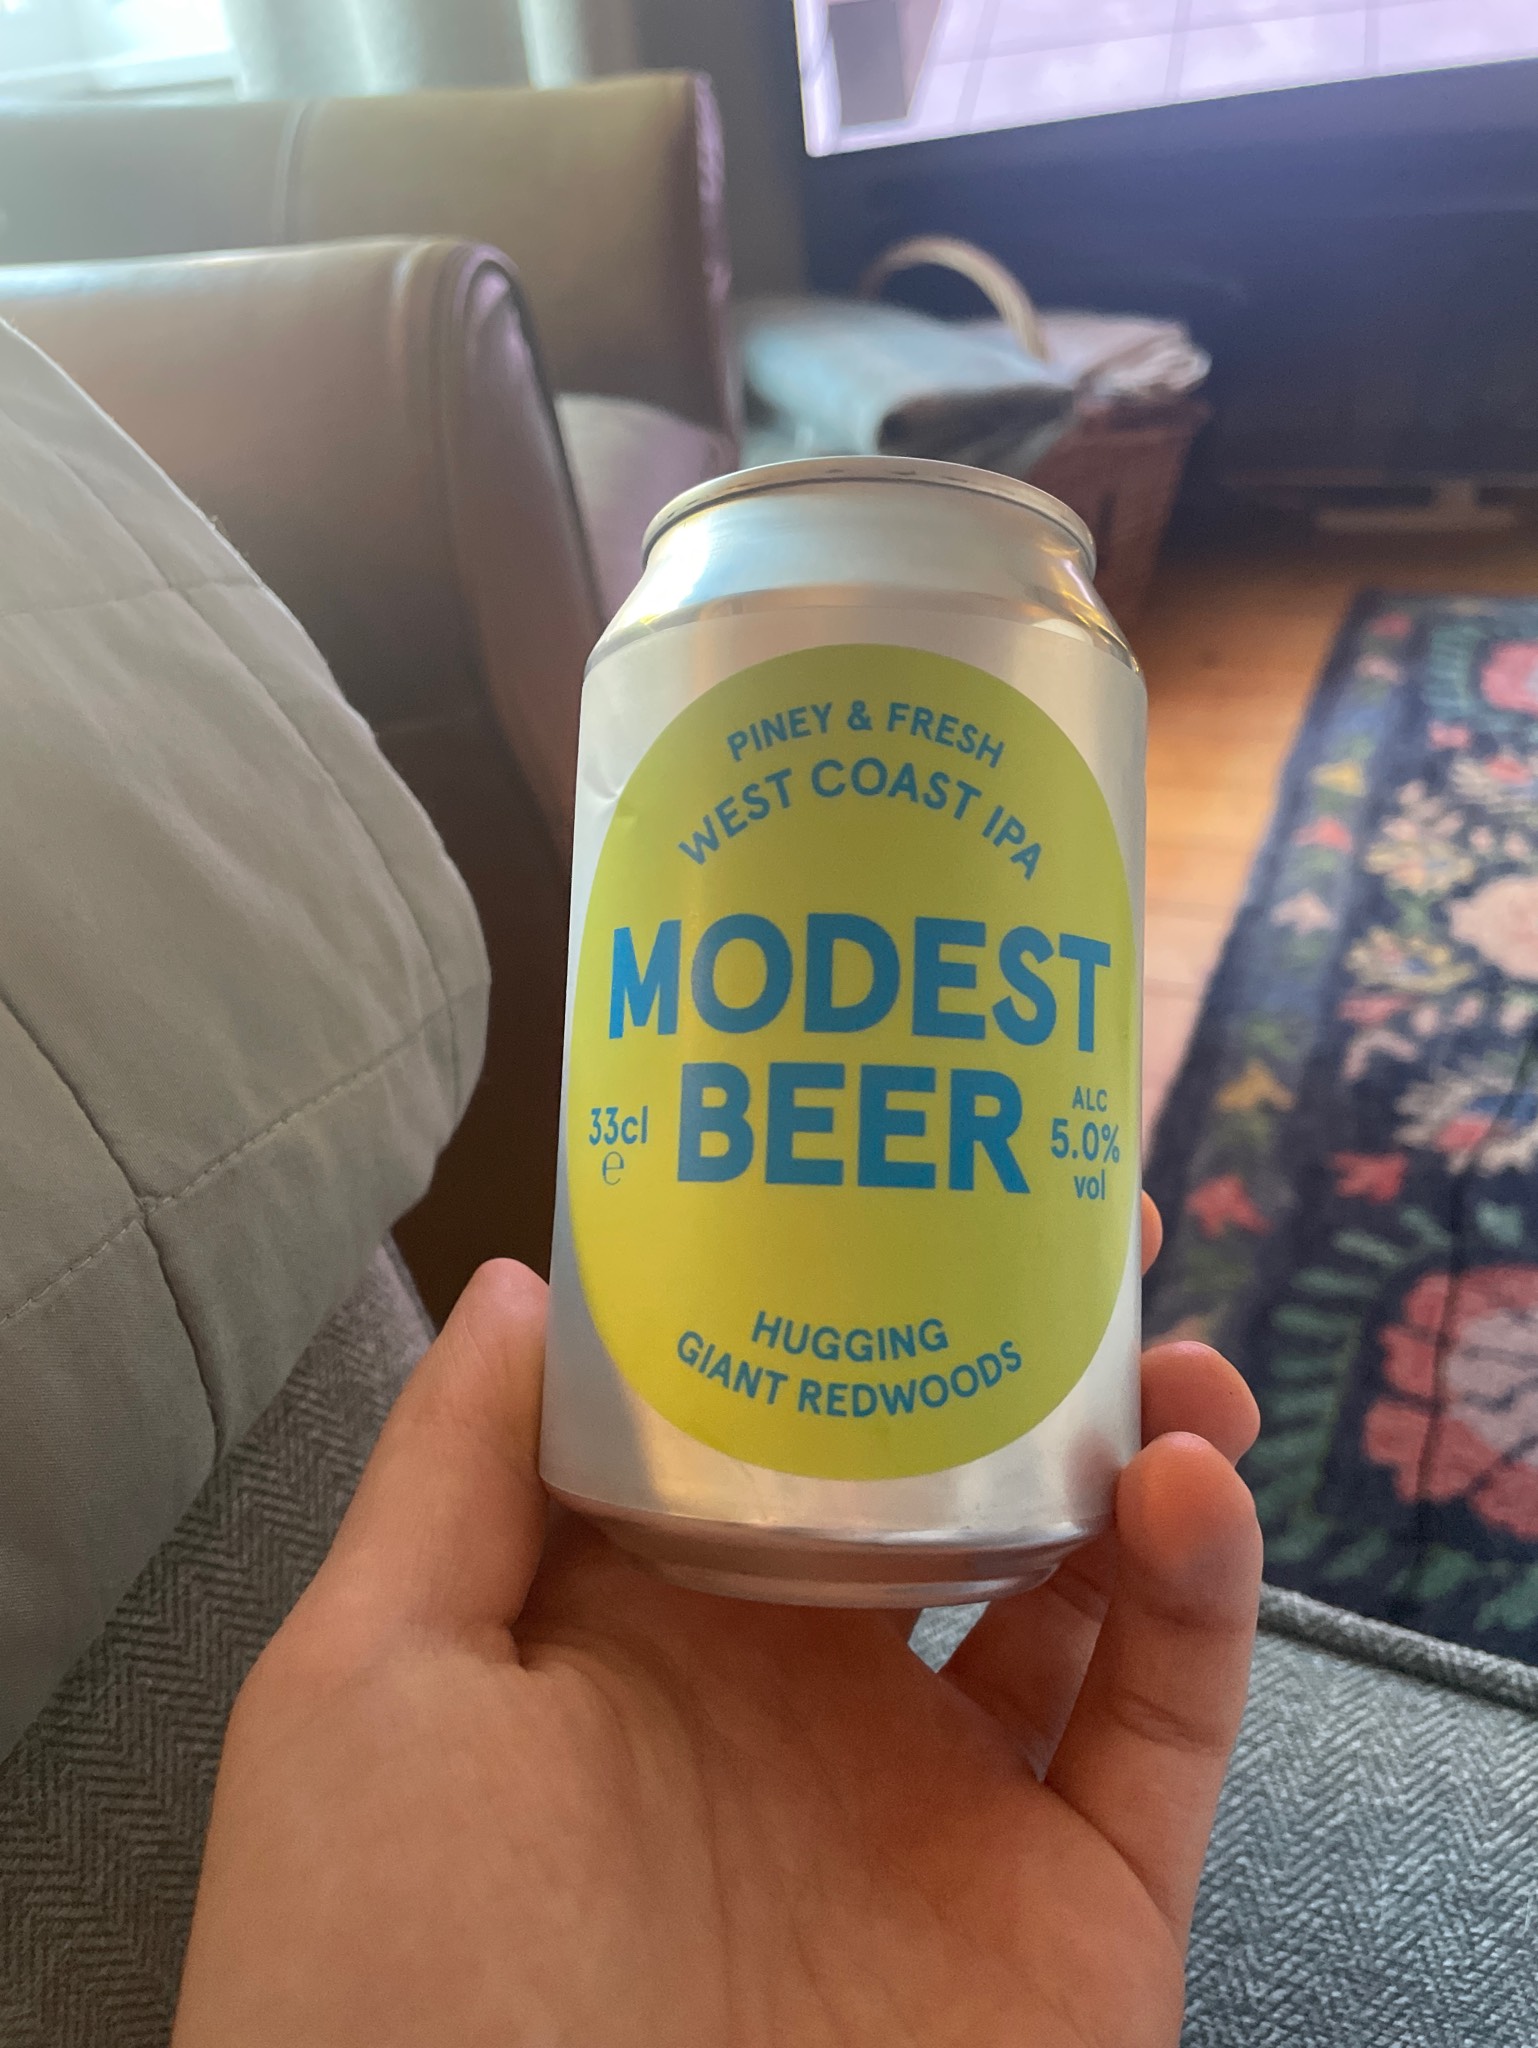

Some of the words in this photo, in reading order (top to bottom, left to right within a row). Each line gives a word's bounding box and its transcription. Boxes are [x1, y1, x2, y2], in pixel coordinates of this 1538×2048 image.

[727, 701, 833, 762] PINEY
[847, 700, 872, 730] &
[887, 702, 1005, 768] FRESH
[678, 768, 793, 865] WEST
[810, 757, 982, 820] COAST
[982, 806, 1042, 880] IPA
[609, 913, 1111, 1053] MODEST
[588, 1107, 648, 1145] 33cl
[677, 1062, 1031, 1194] BEER
[1071, 1086, 1108, 1112] ALC
[1050, 1117, 1120, 1164] 5.0%
[1073, 1170, 1106, 1201] vol
[752, 1311, 949, 1362] HUGGING
[677, 1331, 788, 1405] GIANT
[798, 1341, 1023, 1418] REDWOODS
